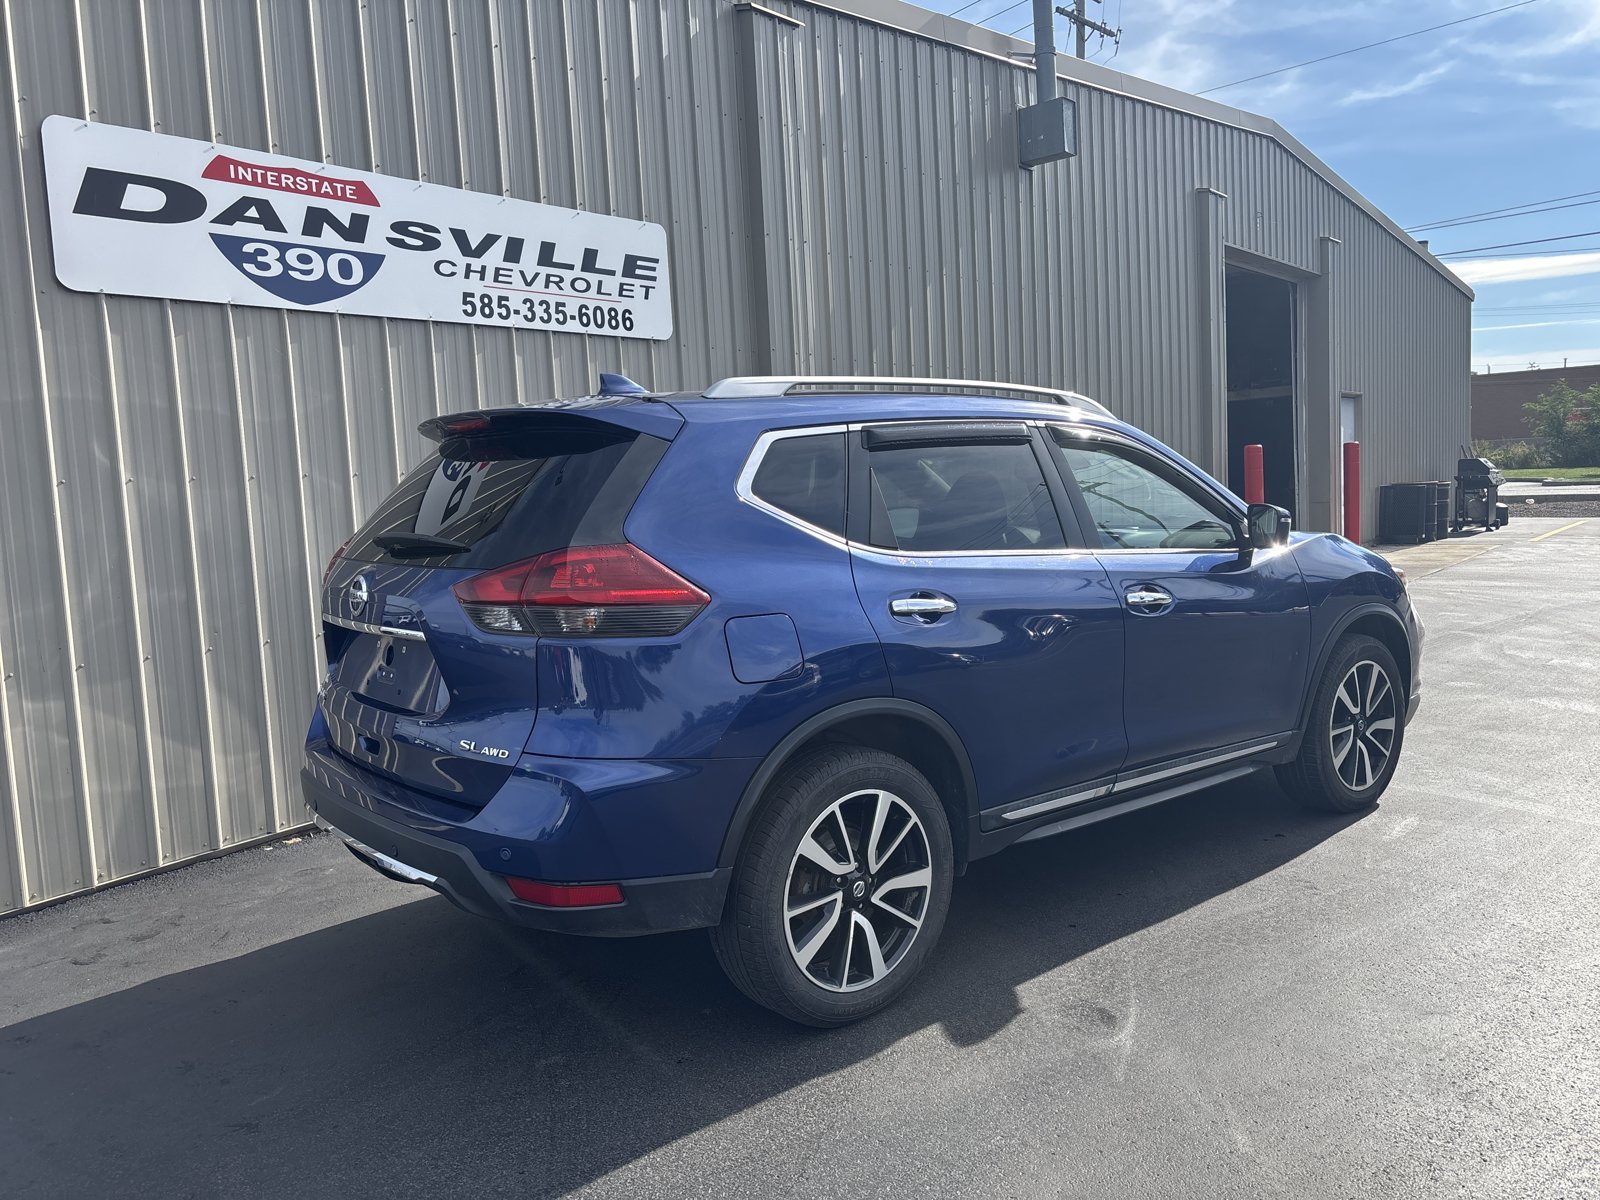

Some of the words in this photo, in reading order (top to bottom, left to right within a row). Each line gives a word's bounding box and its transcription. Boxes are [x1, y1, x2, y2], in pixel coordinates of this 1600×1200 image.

[229, 164, 357, 200] INTERSTATE
[242, 242, 364, 286] 390
[433, 259, 656, 301] CHEVROLET
[461, 291, 635, 332] 585-335-6086
[459, 739, 480, 754] SL
[481, 746, 509, 759] AWD
